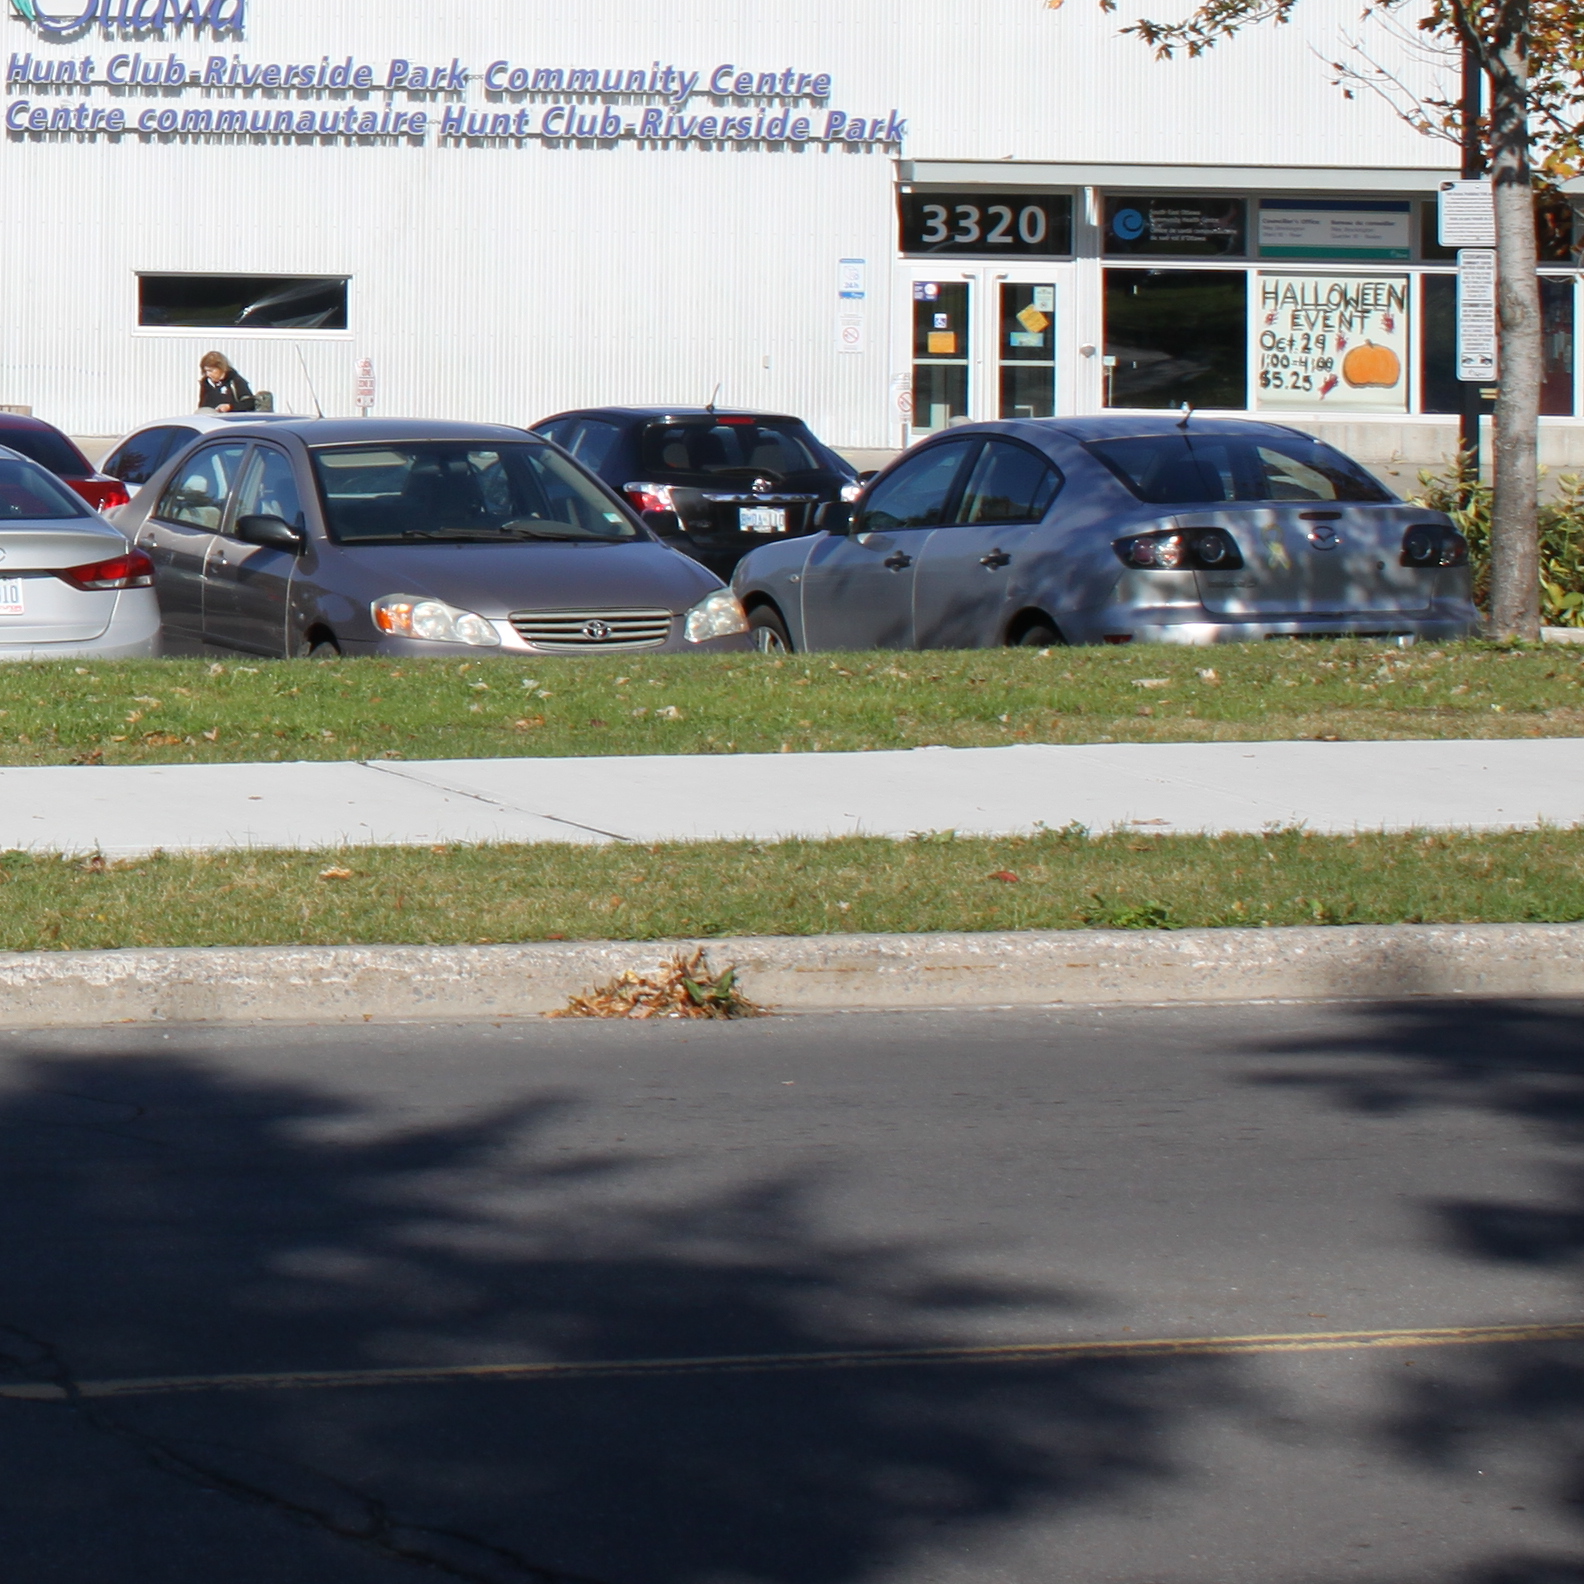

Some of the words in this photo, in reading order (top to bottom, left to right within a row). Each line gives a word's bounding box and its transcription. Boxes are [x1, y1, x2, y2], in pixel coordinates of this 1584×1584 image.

[5, 52, 94, 85] Hunt
[105, 52, 373, 89] Club-Riverside
[386, 57, 469, 90] Park
[484, 59, 699, 102] Community
[708, 64, 832, 97] Centre
[5, 99, 125, 132] Centre
[136, 101, 428, 135] communautaire
[439, 104, 529, 136] Hunt
[540, 104, 811, 140] Club-Riverside
[822, 108, 908, 143] Park
[921, 203, 1047, 244] 3320
[1261, 279, 1407, 314] HALLOWEEN
[1290, 308, 1372, 334] EVENT
[1259, 369, 1313, 392] $5.25
